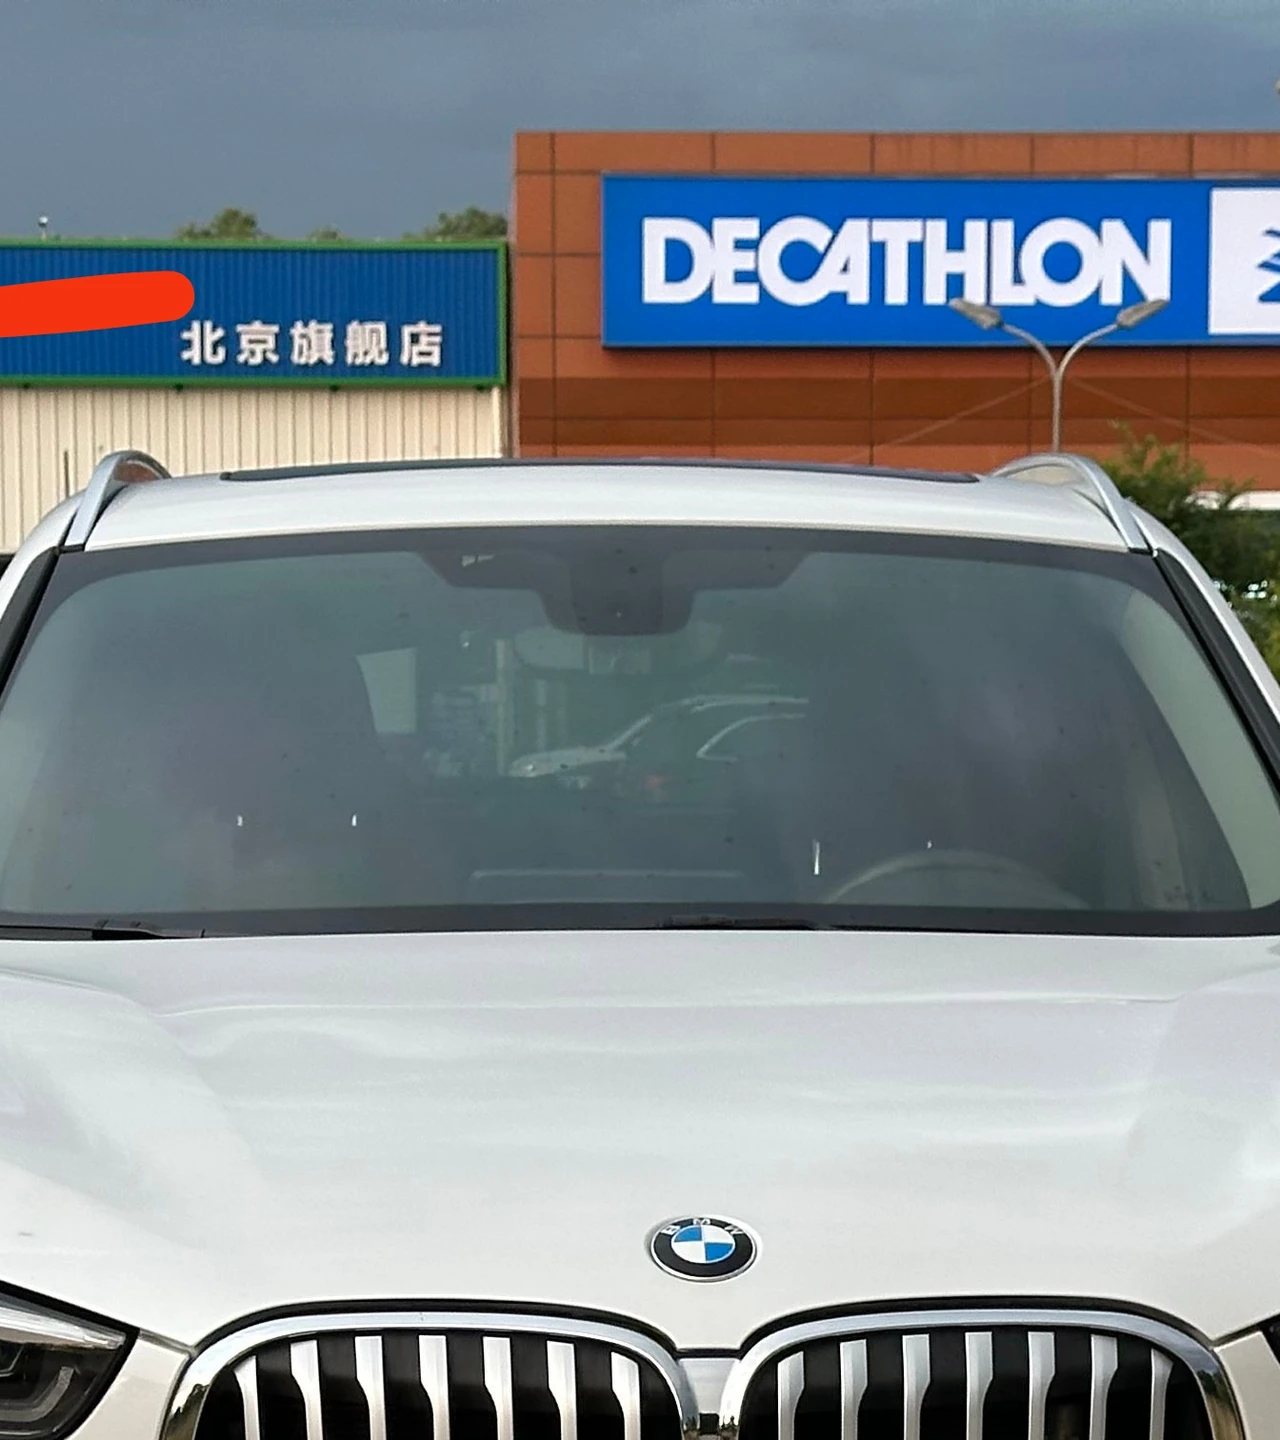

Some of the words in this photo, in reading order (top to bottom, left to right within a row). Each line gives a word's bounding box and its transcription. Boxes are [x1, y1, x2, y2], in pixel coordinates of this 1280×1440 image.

[641, 215, 1172, 307] DECATHLON
[179, 319, 444, 368] 北京旗舰店
